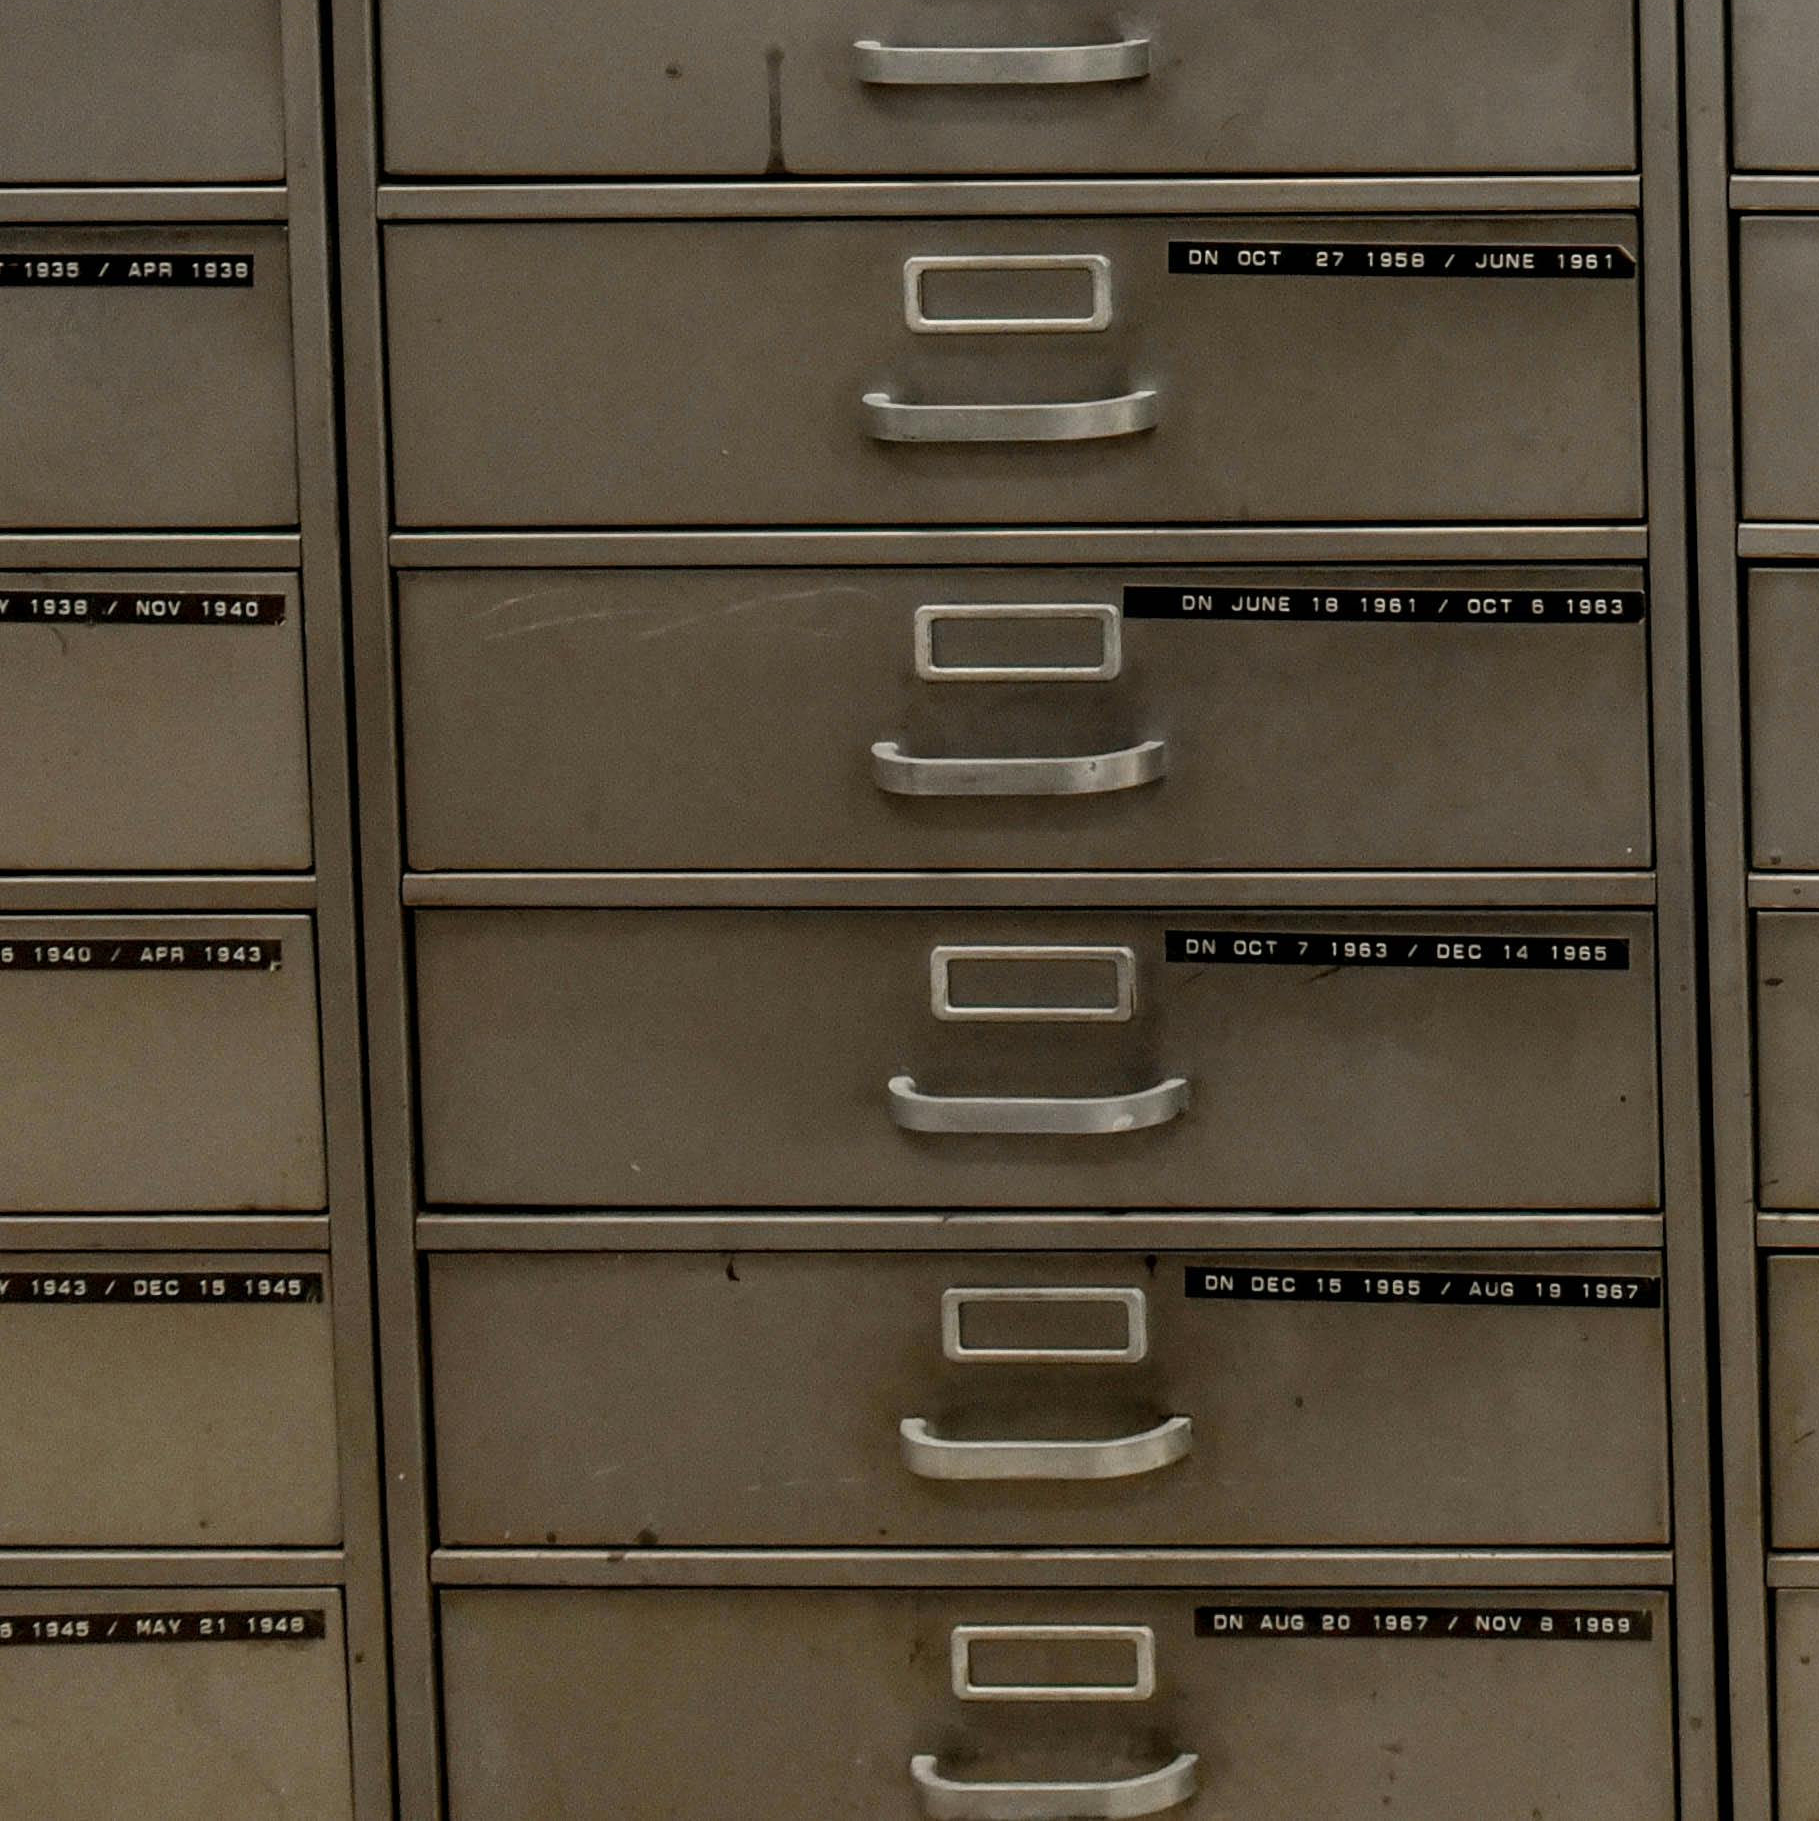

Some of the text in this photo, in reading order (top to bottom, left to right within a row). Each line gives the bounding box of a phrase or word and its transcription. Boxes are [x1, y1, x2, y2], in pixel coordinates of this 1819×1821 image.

[1213, 1614, 1243, 1630] DN
[1260, 1614, 1305, 1631] AUG
[1322, 1613, 1351, 1632] 20
[1373, 1615, 1428, 1631] 1967
[1475, 1614, 1522, 1632] NOV
[1540, 1616, 1553, 1632] 8
[1574, 1617, 1630, 1634] 1969
